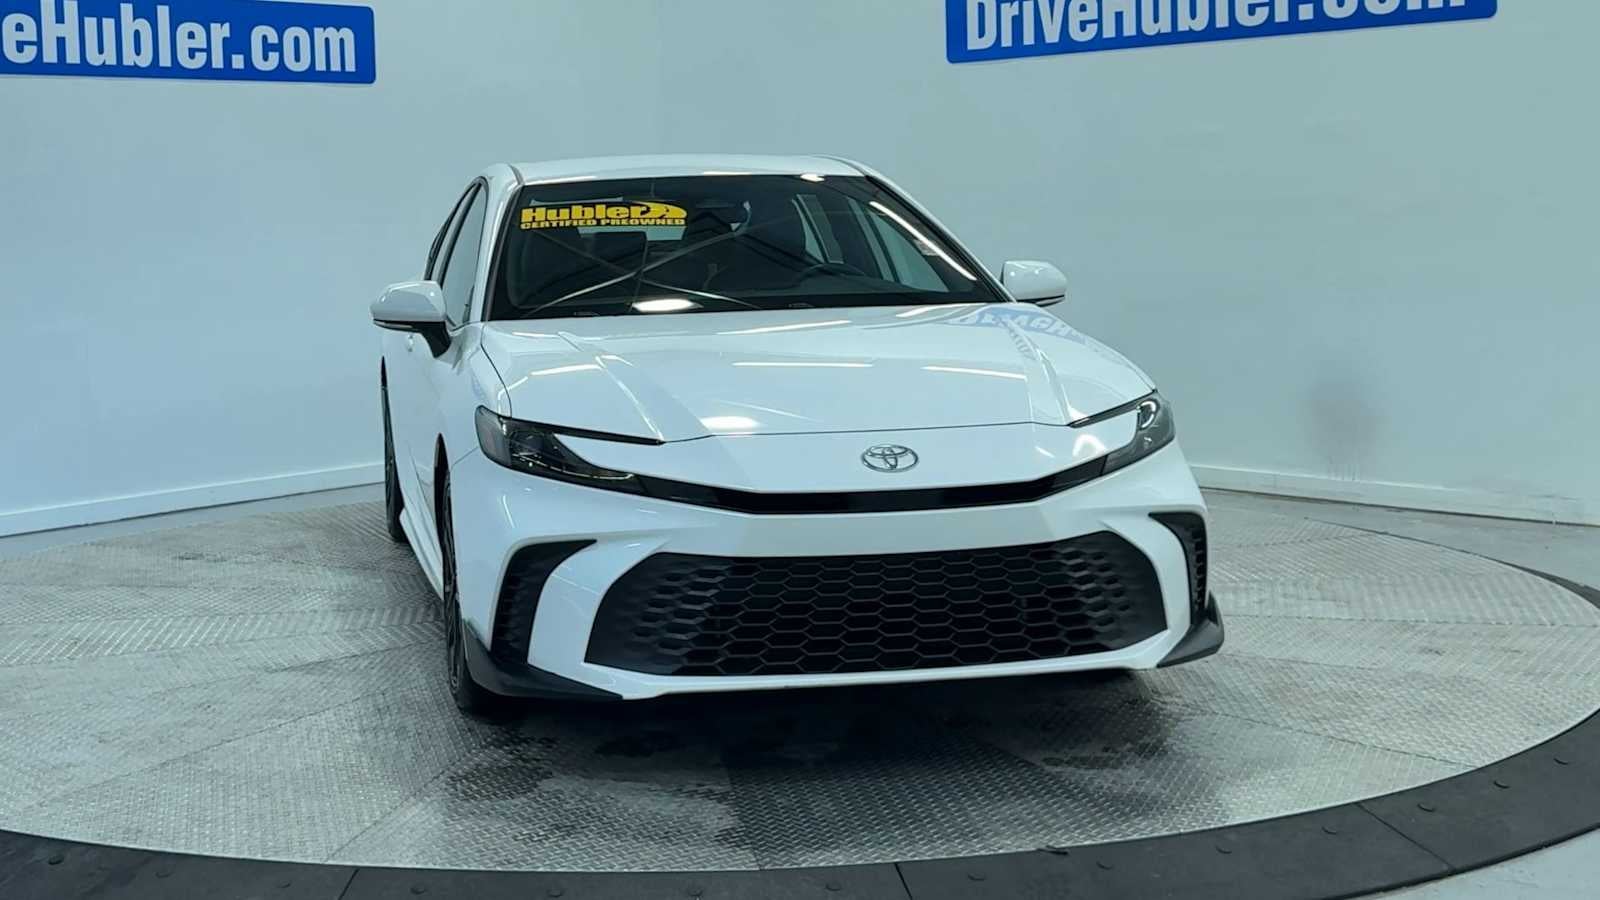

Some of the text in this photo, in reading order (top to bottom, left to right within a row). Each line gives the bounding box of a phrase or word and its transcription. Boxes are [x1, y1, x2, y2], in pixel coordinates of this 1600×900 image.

[1, 0, 356, 73] eHubler.com
[967, 0, 1466, 50] DriveHube.
[520, 217, 686, 229] CERTIFIED PREOWNED
[521, 203, 652, 222] Hubler
